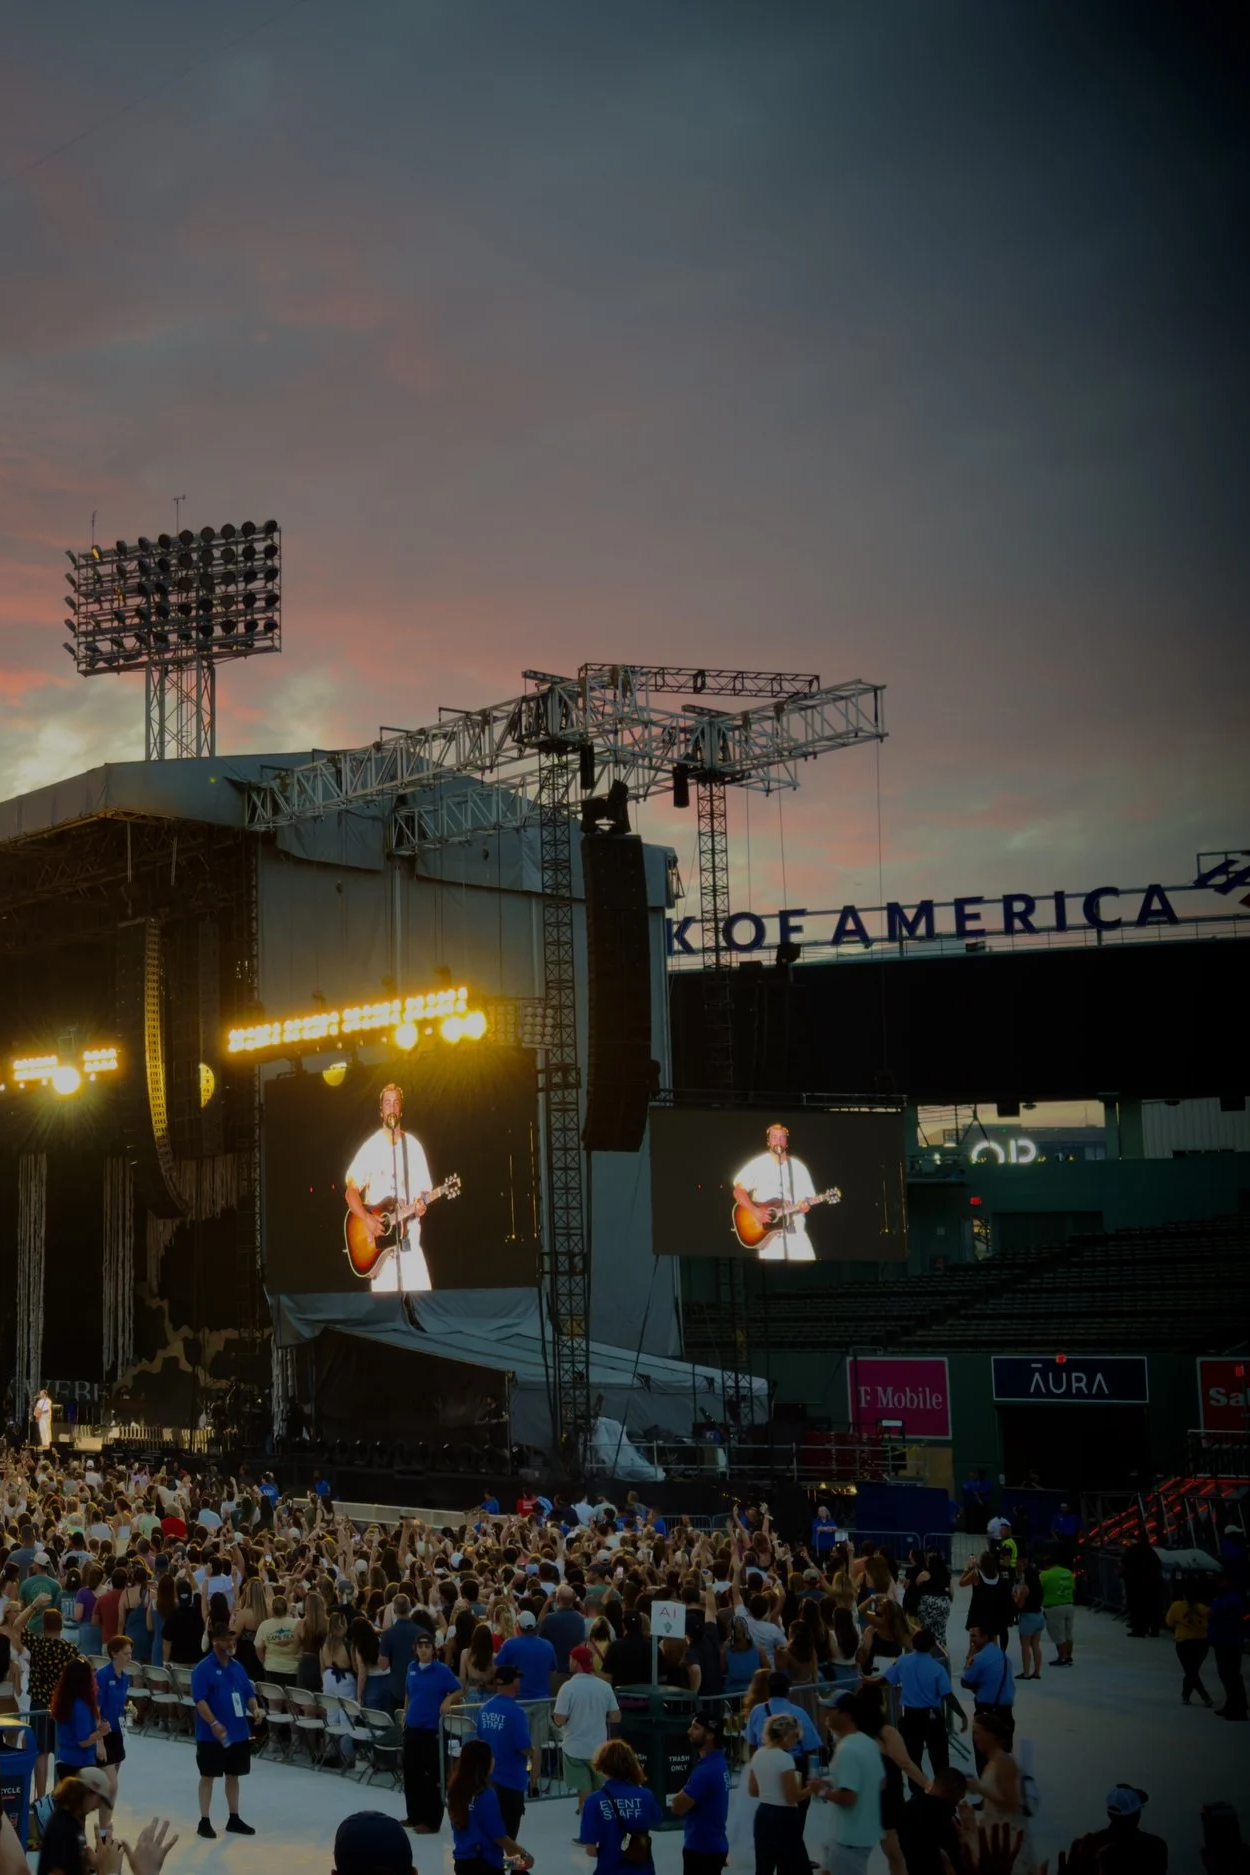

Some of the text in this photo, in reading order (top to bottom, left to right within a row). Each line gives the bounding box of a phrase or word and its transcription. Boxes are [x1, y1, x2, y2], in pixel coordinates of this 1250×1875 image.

[722, 908, 807, 952] OF
[832, 884, 1180, 946] AMERICA
[877, 1386, 943, 1410] Mobile
[481, 1712, 506, 1723] EVENT
[483, 1720, 505, 1731] STAFF
[670, 1764, 688, 1772] ONLY
